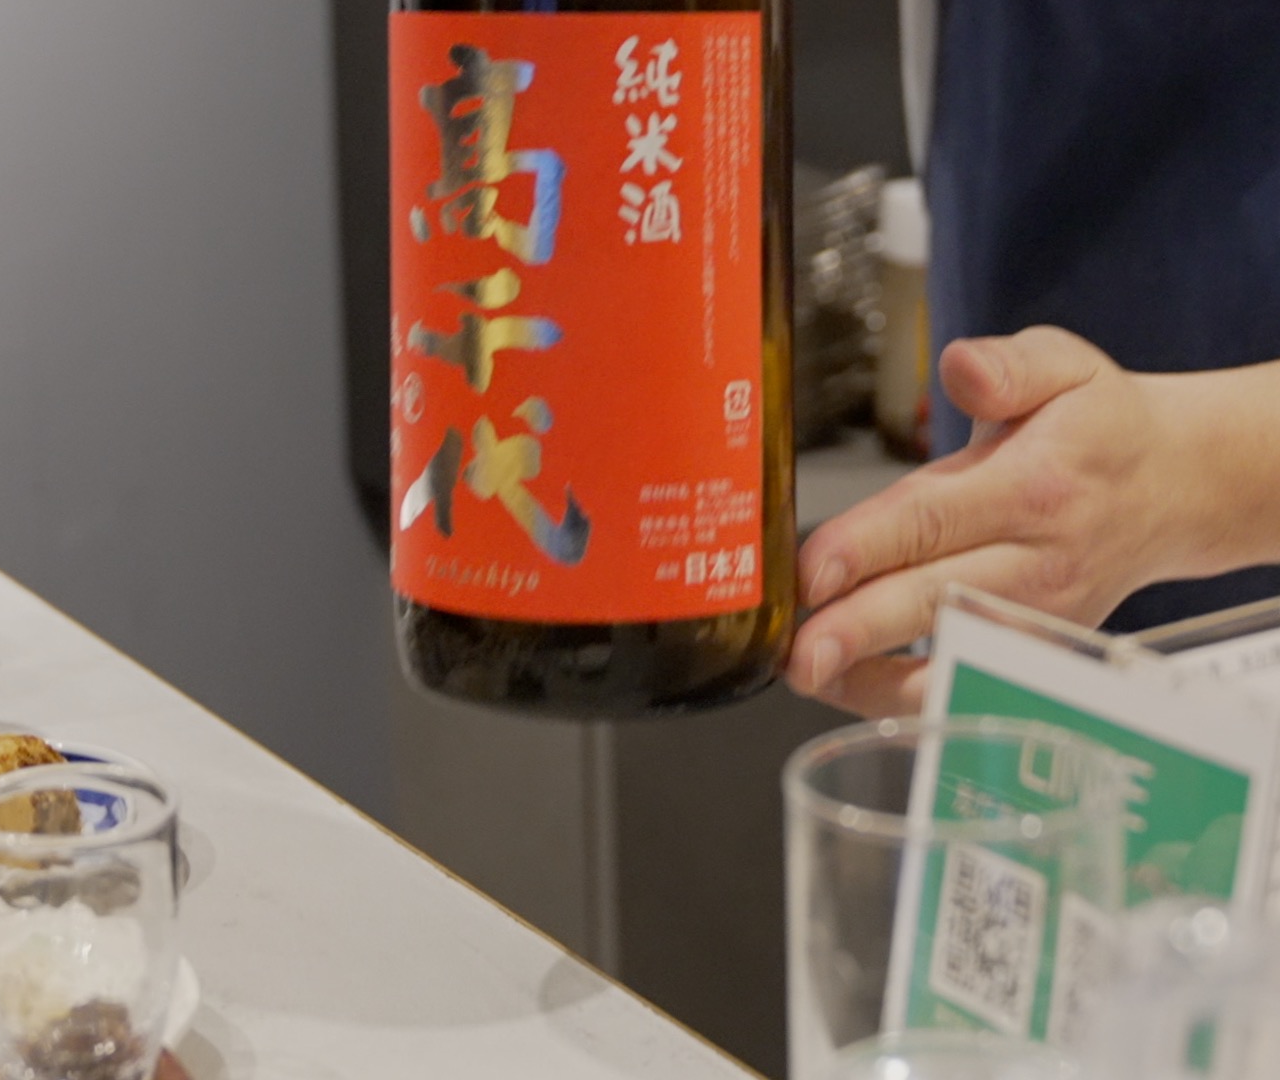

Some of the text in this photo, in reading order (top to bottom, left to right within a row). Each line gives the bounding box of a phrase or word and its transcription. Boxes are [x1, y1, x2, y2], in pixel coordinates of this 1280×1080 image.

[612, 34, 684, 245] 純米酒
[684, 542, 756, 586] 日本酒
